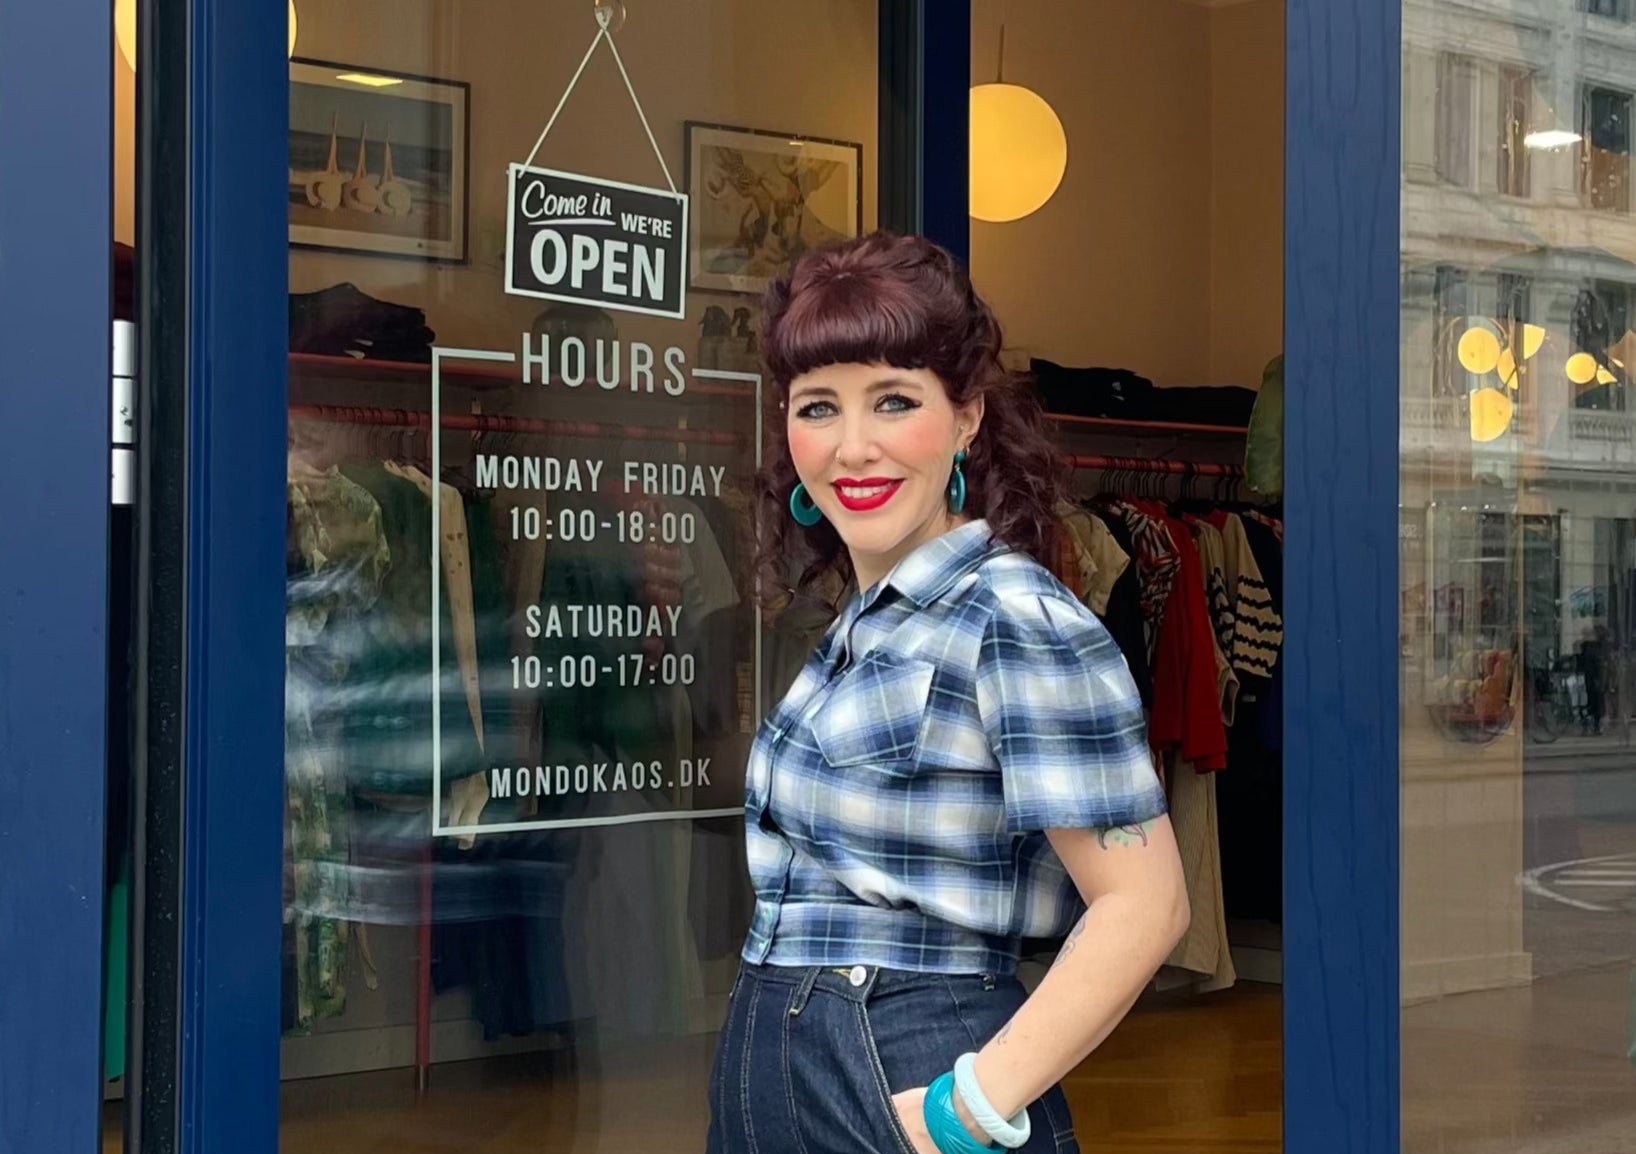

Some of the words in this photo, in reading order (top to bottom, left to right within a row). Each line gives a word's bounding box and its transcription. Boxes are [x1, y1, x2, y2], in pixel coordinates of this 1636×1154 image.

[521, 180, 587, 218] Come
[591, 191, 612, 217] in
[620, 212, 673, 239] WE'RE
[529, 228, 666, 302] OPEN
[521, 331, 687, 397] HOURS
[476, 454, 604, 492] MONDAY
[623, 462, 726, 496] FRIDAY
[510, 507, 696, 543] 10:00-18:00
[526, 605, 683, 639] SATURDAY
[511, 653, 696, 689] 10:00-17:00
[491, 758, 712, 799] MONDOKAOS.DK
